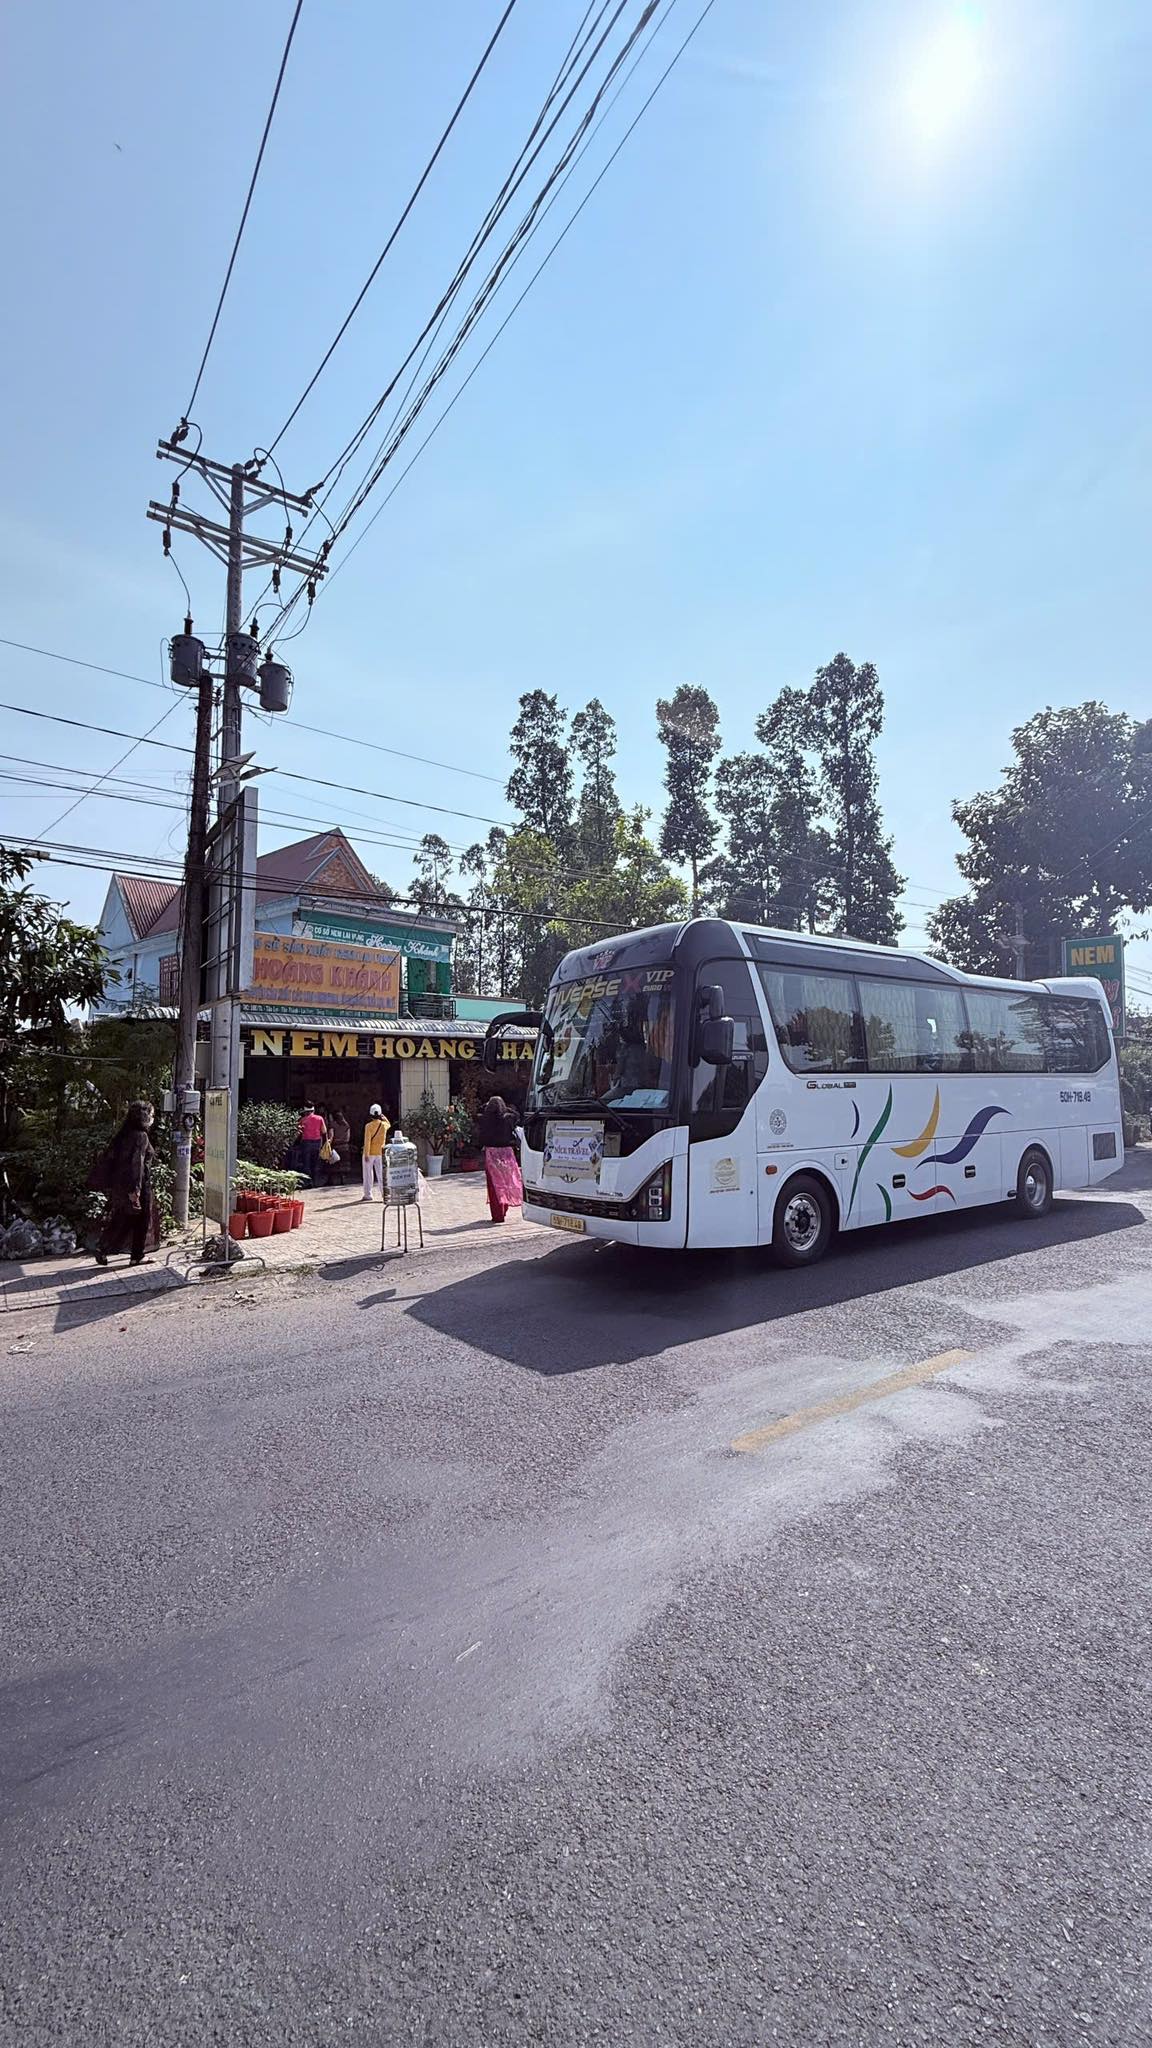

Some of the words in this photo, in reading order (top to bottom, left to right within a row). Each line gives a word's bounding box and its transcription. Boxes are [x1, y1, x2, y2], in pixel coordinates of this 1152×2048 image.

[1071, 945, 1115, 966] NEM
[646, 970, 675, 983] VIP
[250, 1030, 360, 1058] NEM
[372, 1037, 477, 1060] HOANG
